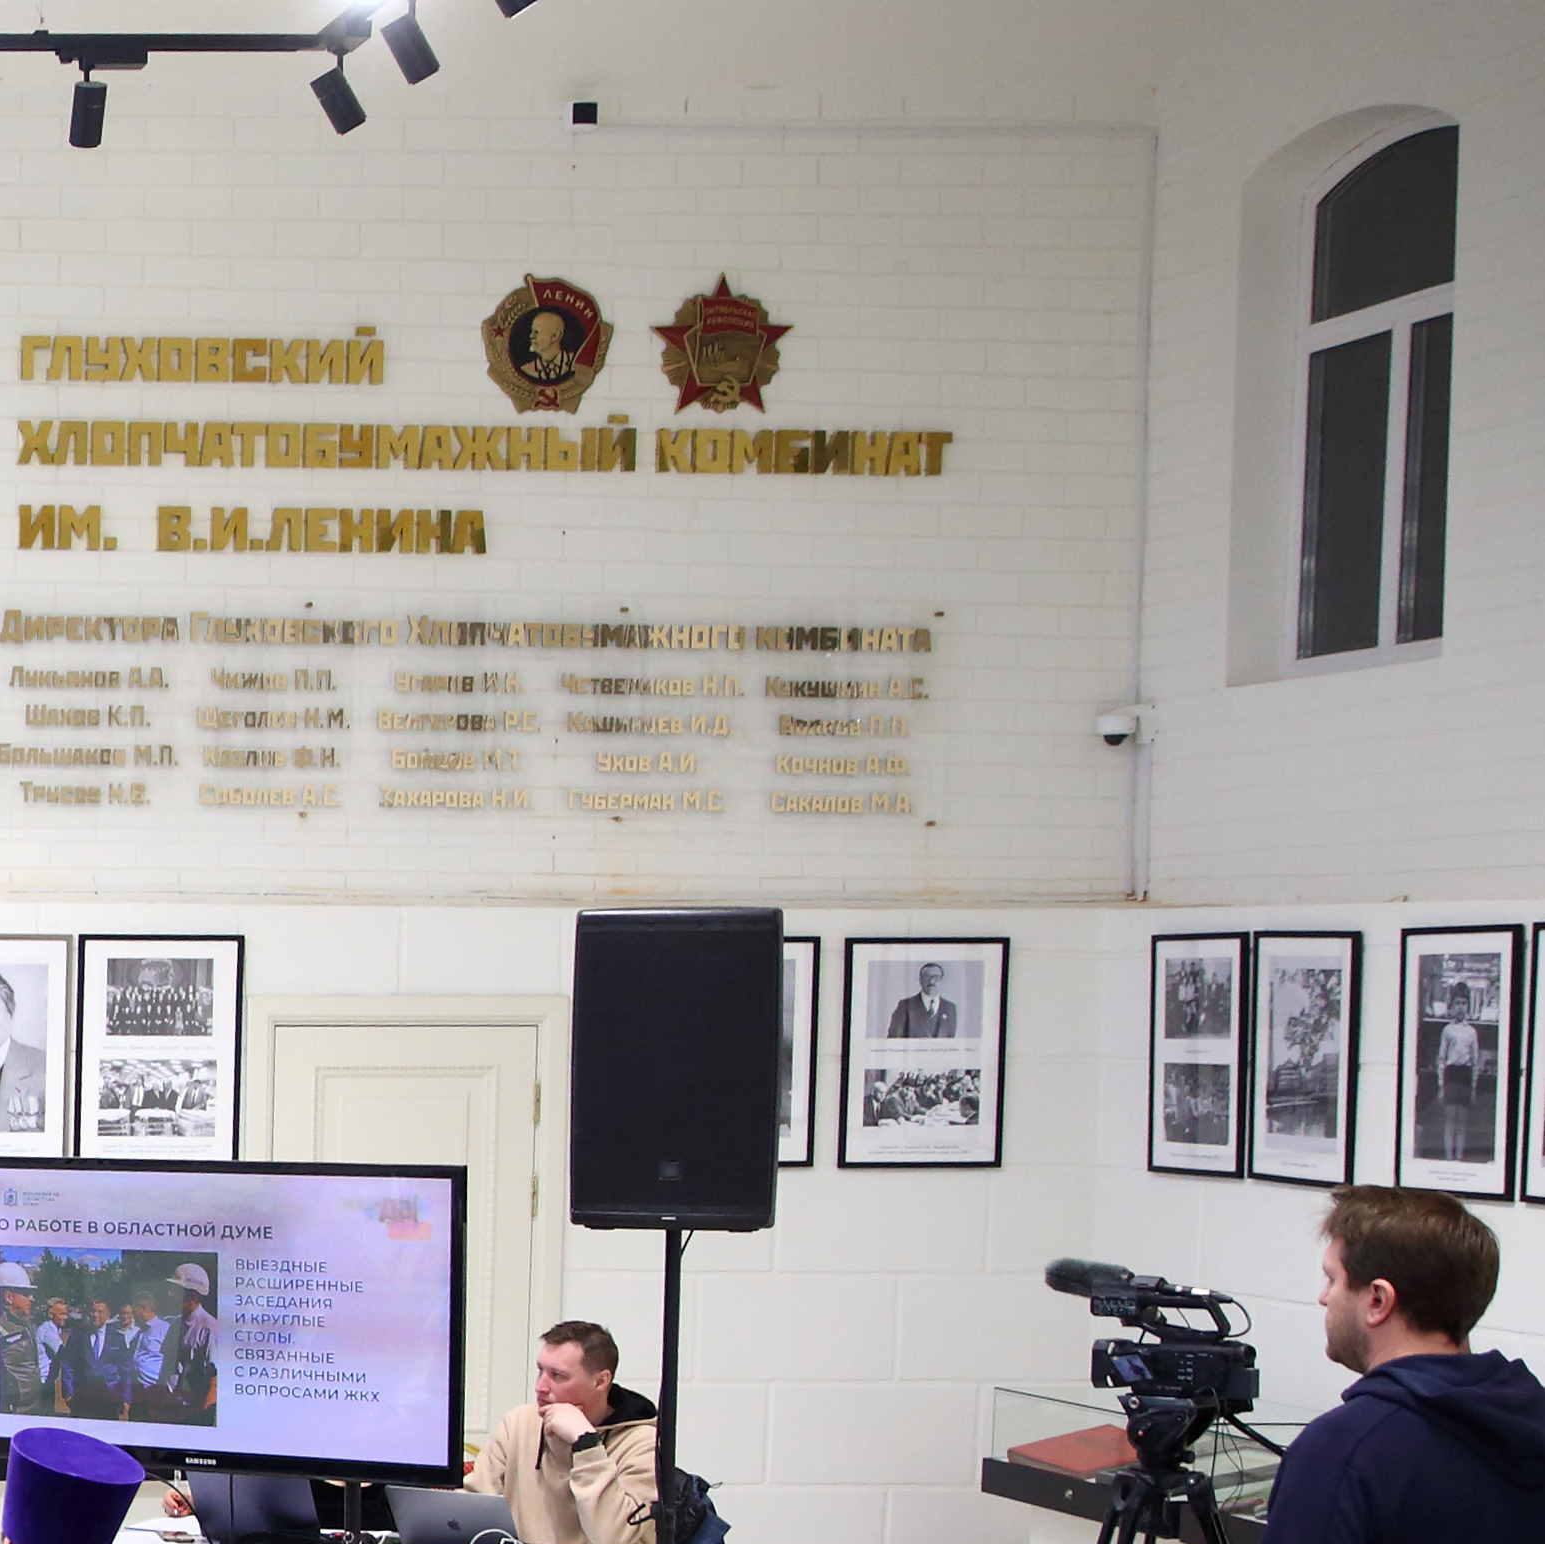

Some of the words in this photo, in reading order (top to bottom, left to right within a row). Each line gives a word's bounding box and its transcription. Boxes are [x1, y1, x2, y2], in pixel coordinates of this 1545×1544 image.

[541, 289, 594, 320] ЛЕНИН
[20, 326, 384, 385] ГЛУХОВСКИЙ
[16, 414, 637, 474] ХЛОПЧАТОБУМАЖНЫЙ
[655, 428, 953, 476] КОМБИНАТ
[18, 504, 118, 551] ИМ.
[156, 505, 487, 554] В.И.ЛЕНИНА
[15, 1219, 82, 1234] РАБОТЕ
[88, 1221, 99, 1234] В
[103, 1221, 216, 1238] ОБЛАСТНОЙ
[221, 1225, 273, 1241] ДУМЕ
[235, 1258, 327, 1273] ВЫЕЗДНЫЕ
[235, 1277, 364, 1293] РАСШИРЕННЫЕ
[235, 1294, 333, 1309] ЗАСЕДАНИЯ
[235, 1313, 246, 1325] И
[251, 1313, 326, 1328] КРУГЛЫЕ
[234, 1348, 335, 1364] СВЯЗАННЫЕ
[234, 1366, 244, 1378] С
[249, 1367, 367, 1383] РАЗЛИЧНЫМИ
[234, 1384, 339, 1400] ВОПРОСАМИ
[344, 1389, 381, 1402] ЖКХ
